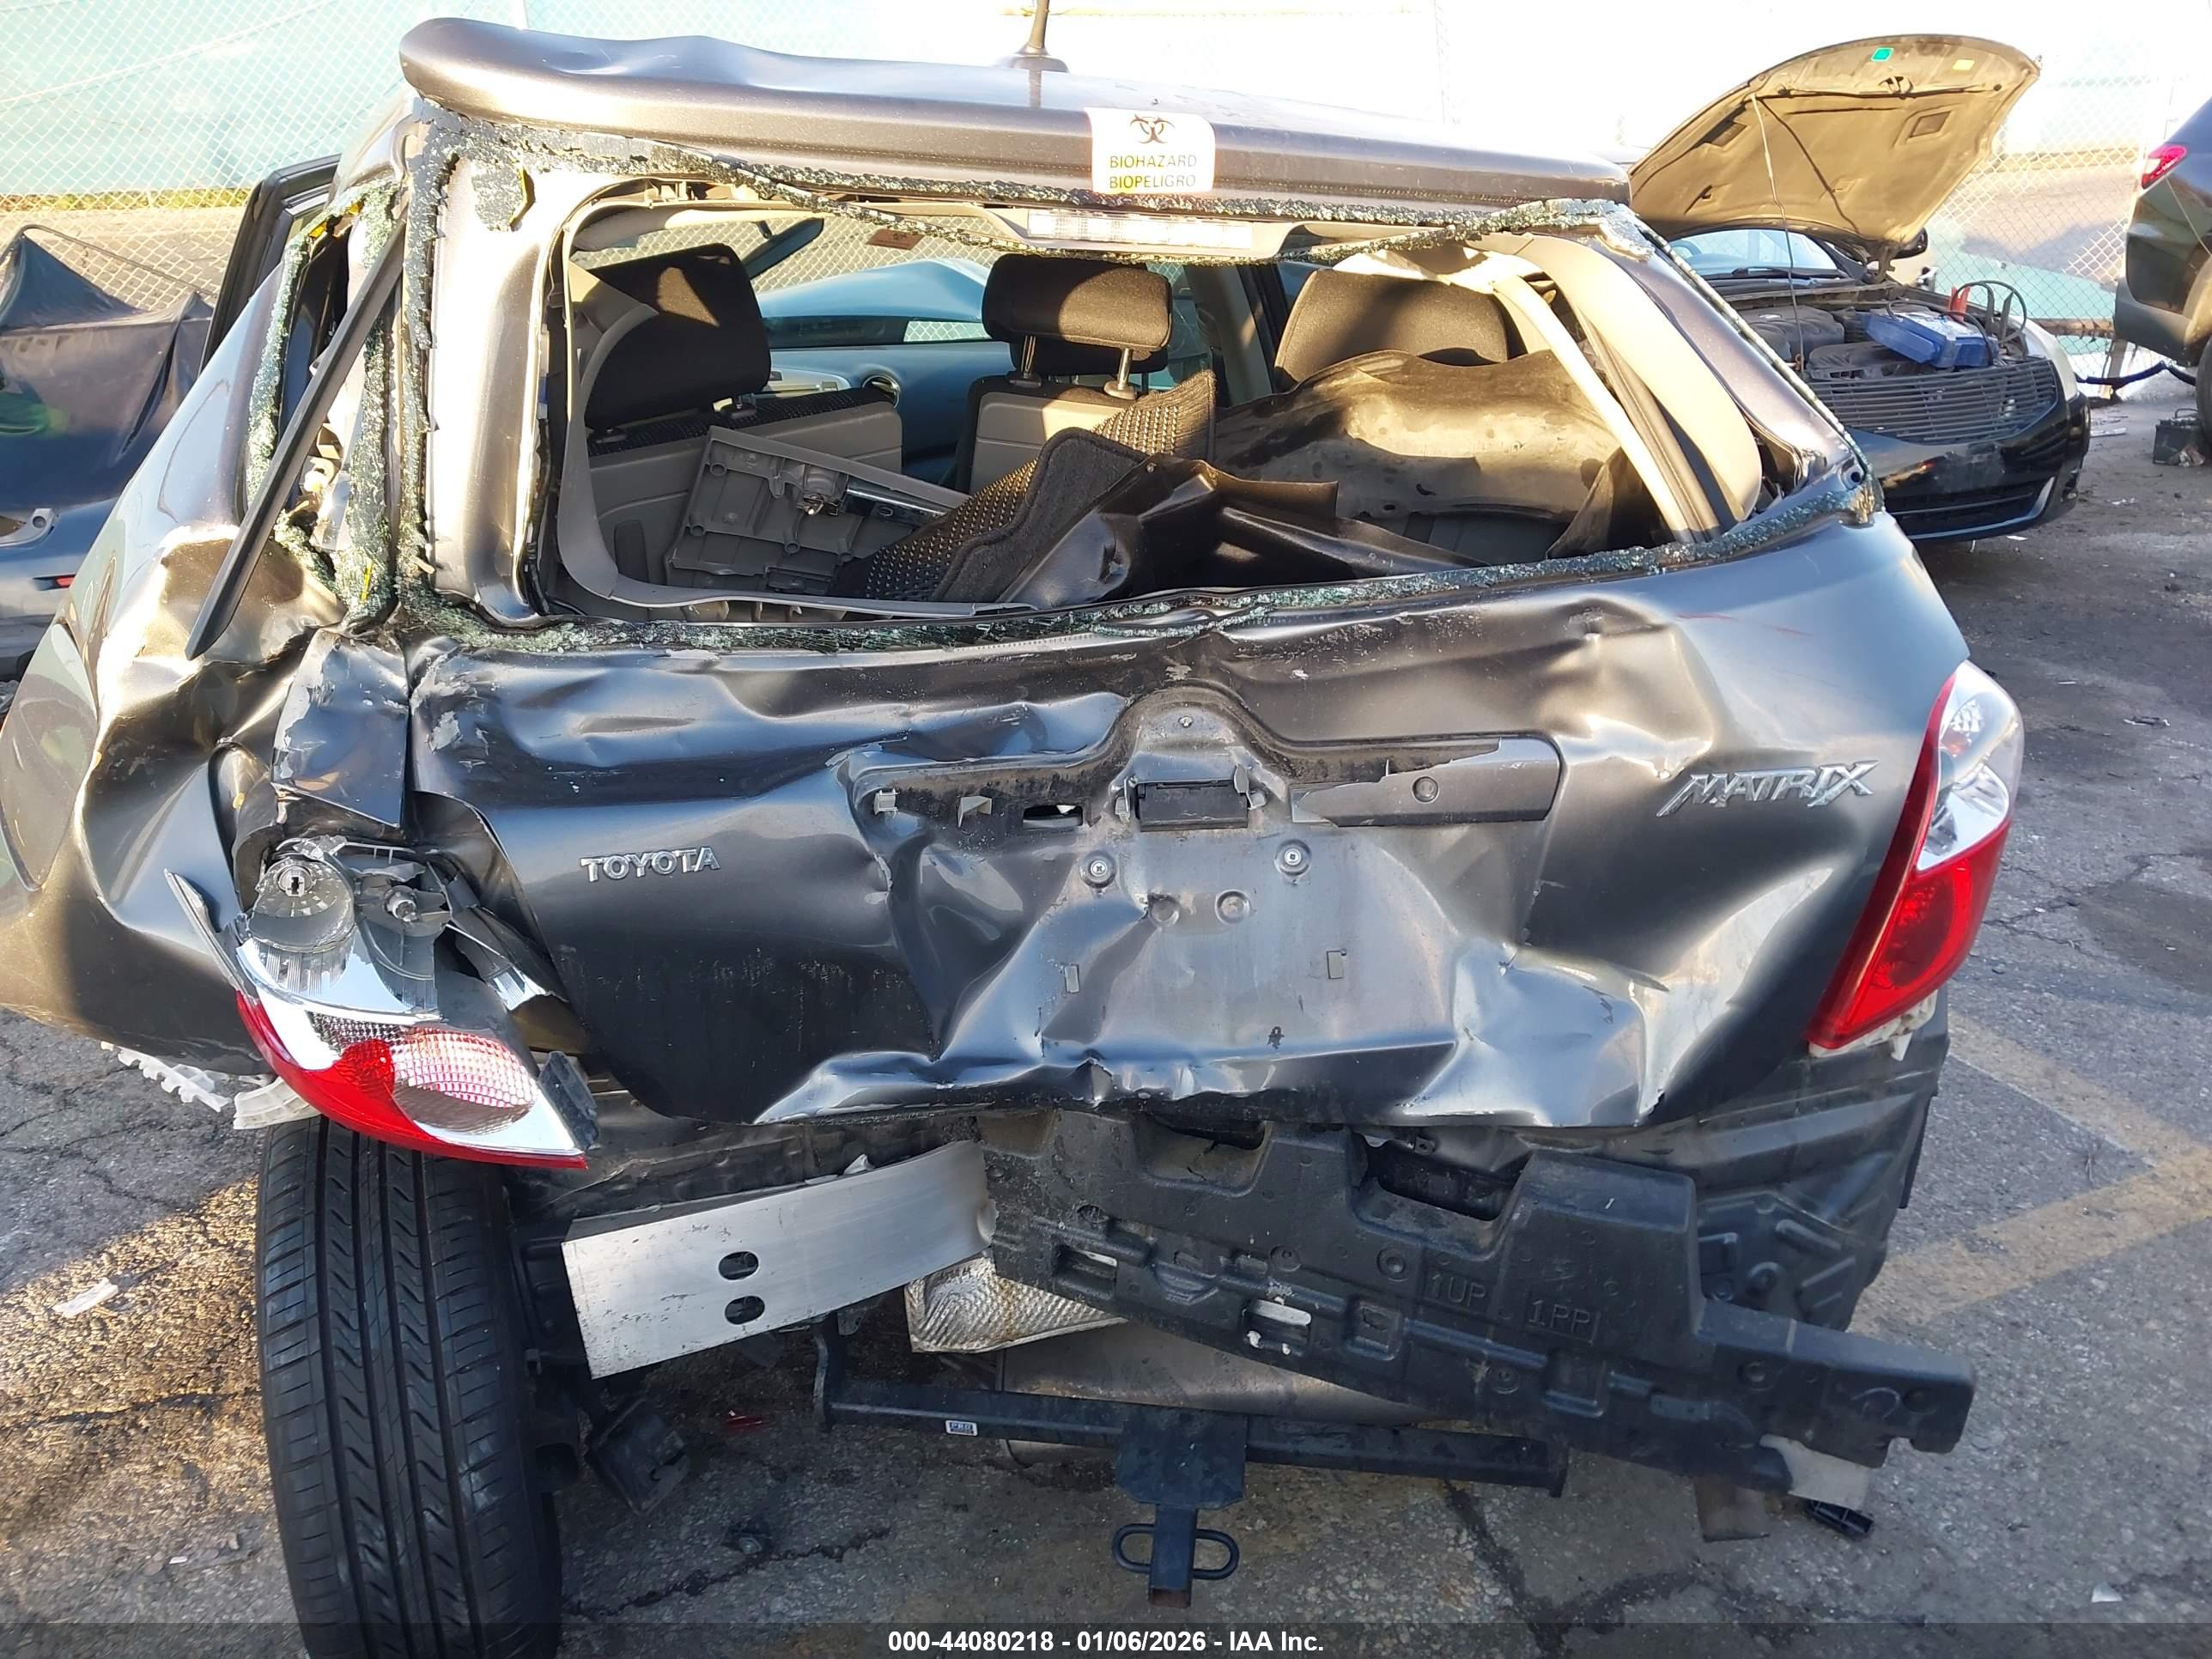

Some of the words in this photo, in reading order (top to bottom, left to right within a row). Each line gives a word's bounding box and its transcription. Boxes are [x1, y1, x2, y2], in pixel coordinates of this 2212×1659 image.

[1109, 155, 1197, 168] BIOHAZARD
[1109, 174, 1196, 188] BIOPELIGRO
[1656, 760, 1879, 817] MATRIX
[580, 846, 721, 882] TOYOTA
